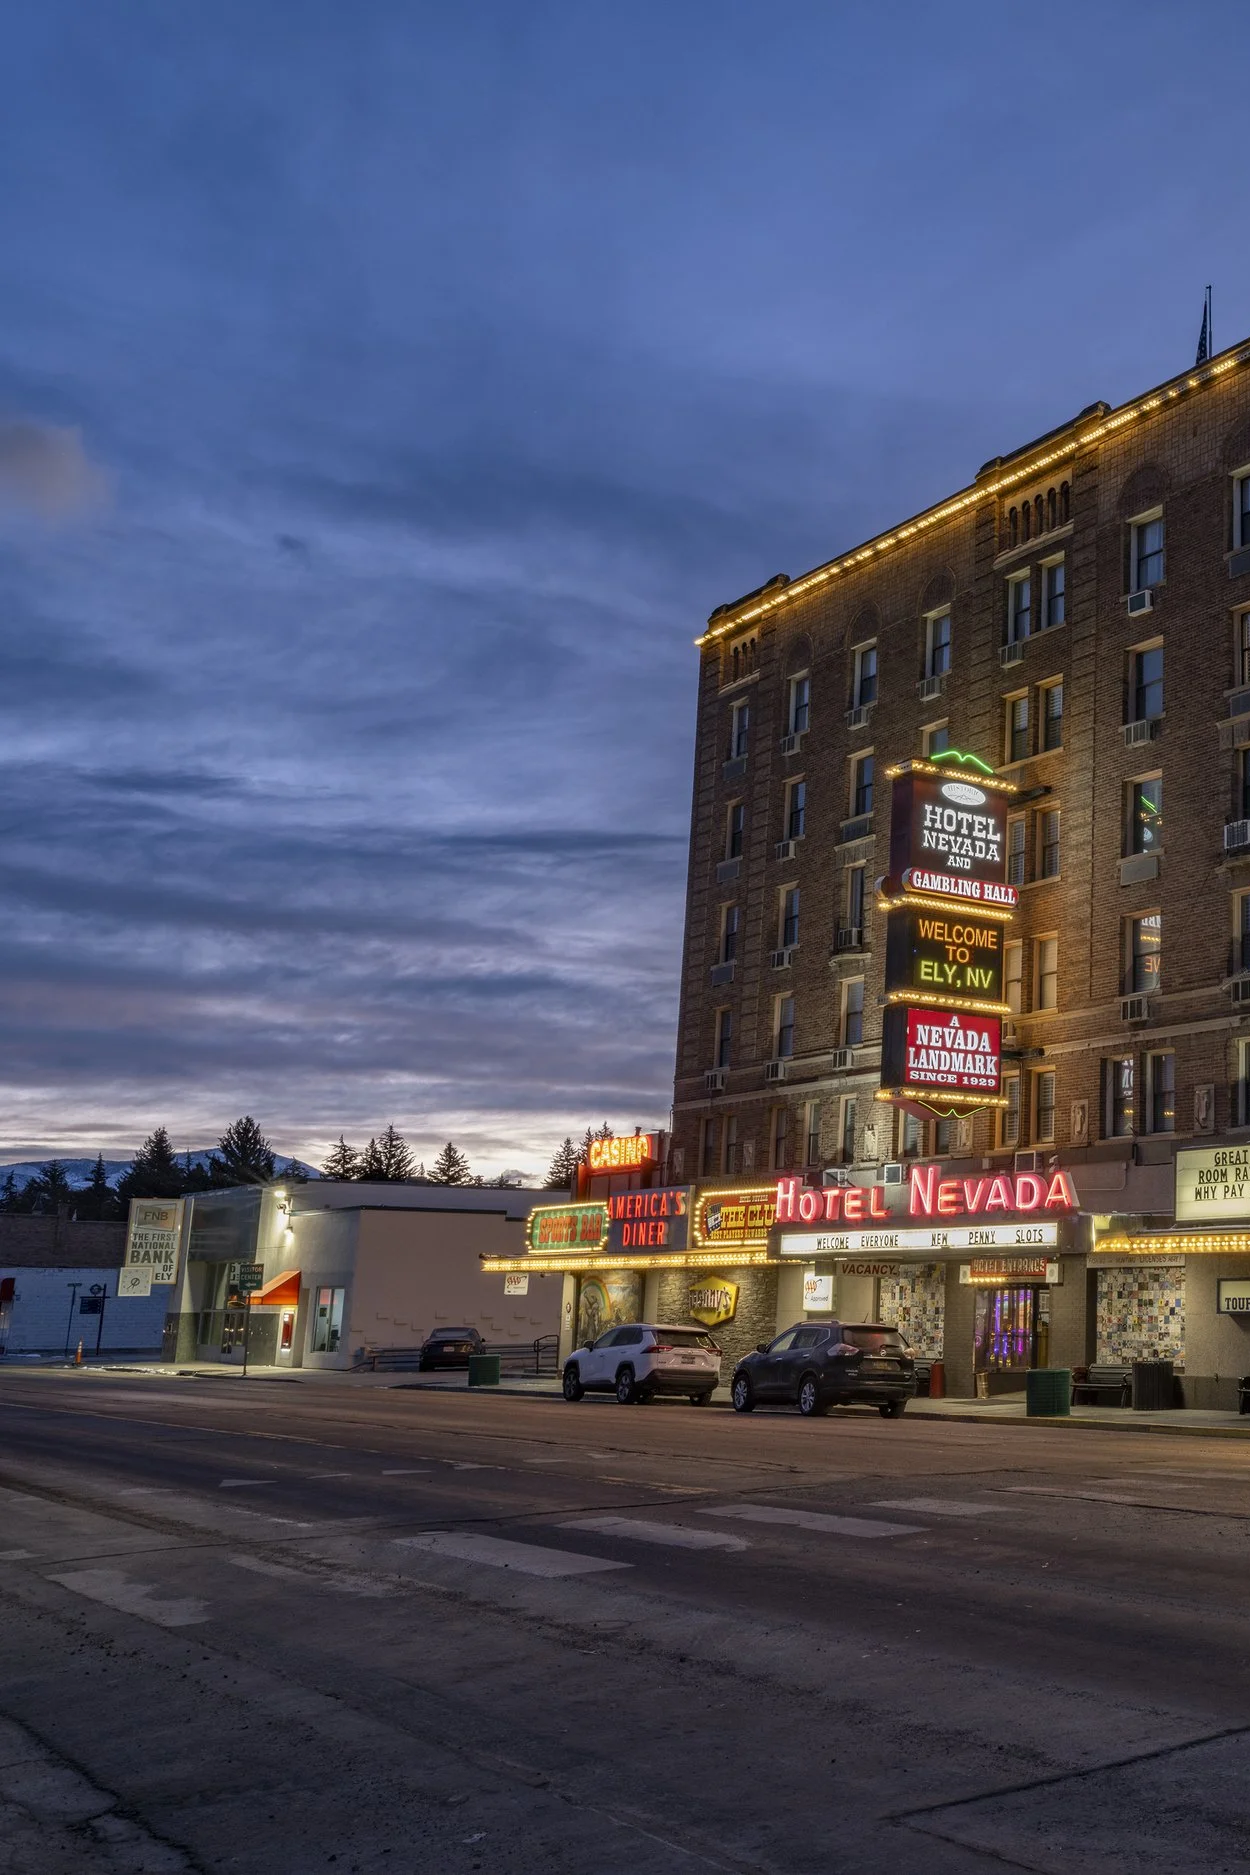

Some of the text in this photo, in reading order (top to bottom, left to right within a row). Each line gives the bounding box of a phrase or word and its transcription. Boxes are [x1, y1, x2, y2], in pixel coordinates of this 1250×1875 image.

[924, 804, 1000, 841] HOTEL
[923, 830, 1000, 861] NEVADA
[947, 855, 971, 869] AND
[912, 871, 1015, 904] GAMBLING HALL
[919, 919, 997, 949] WELCOME
[945, 945, 969, 963] TO
[921, 960, 993, 989] ELY, NV
[949, 1016, 960, 1027] A
[916, 1025, 991, 1052] NEVADA
[908, 1047, 998, 1075] LANDMARK
[910, 1070, 996, 1087] SINCE 1929
[590, 1136, 648, 1168] CASINO
[1214, 1150, 1249, 1166] GREAT
[1198, 1168, 1228, 1184] ROOM
[776, 1177, 891, 1221] HOTEL
[909, 1165, 1077, 1216] NEVADA
[1195, 1186, 1217, 1200] WHY
[1223, 1184, 1245, 1199] PAY
[608, 1191, 687, 1219] AMERICA'S
[144, 1211, 169, 1220] FNB
[721, 1205, 746, 1228] THE
[133, 1233, 177, 1241] THE FIRST
[539, 1214, 602, 1243] SPORTS BAR
[623, 1221, 667, 1246] DINER
[131, 1241, 177, 1249] NATIONAL
[817, 1229, 1044, 1250] WELCOME EVERYONE NEW PENNY SLOTS
[130, 1250, 175, 1264] BANK
[155, 1272, 172, 1280] ELY
[162, 1264, 174, 1272] OF
[842, 1264, 895, 1275] VACANCY
